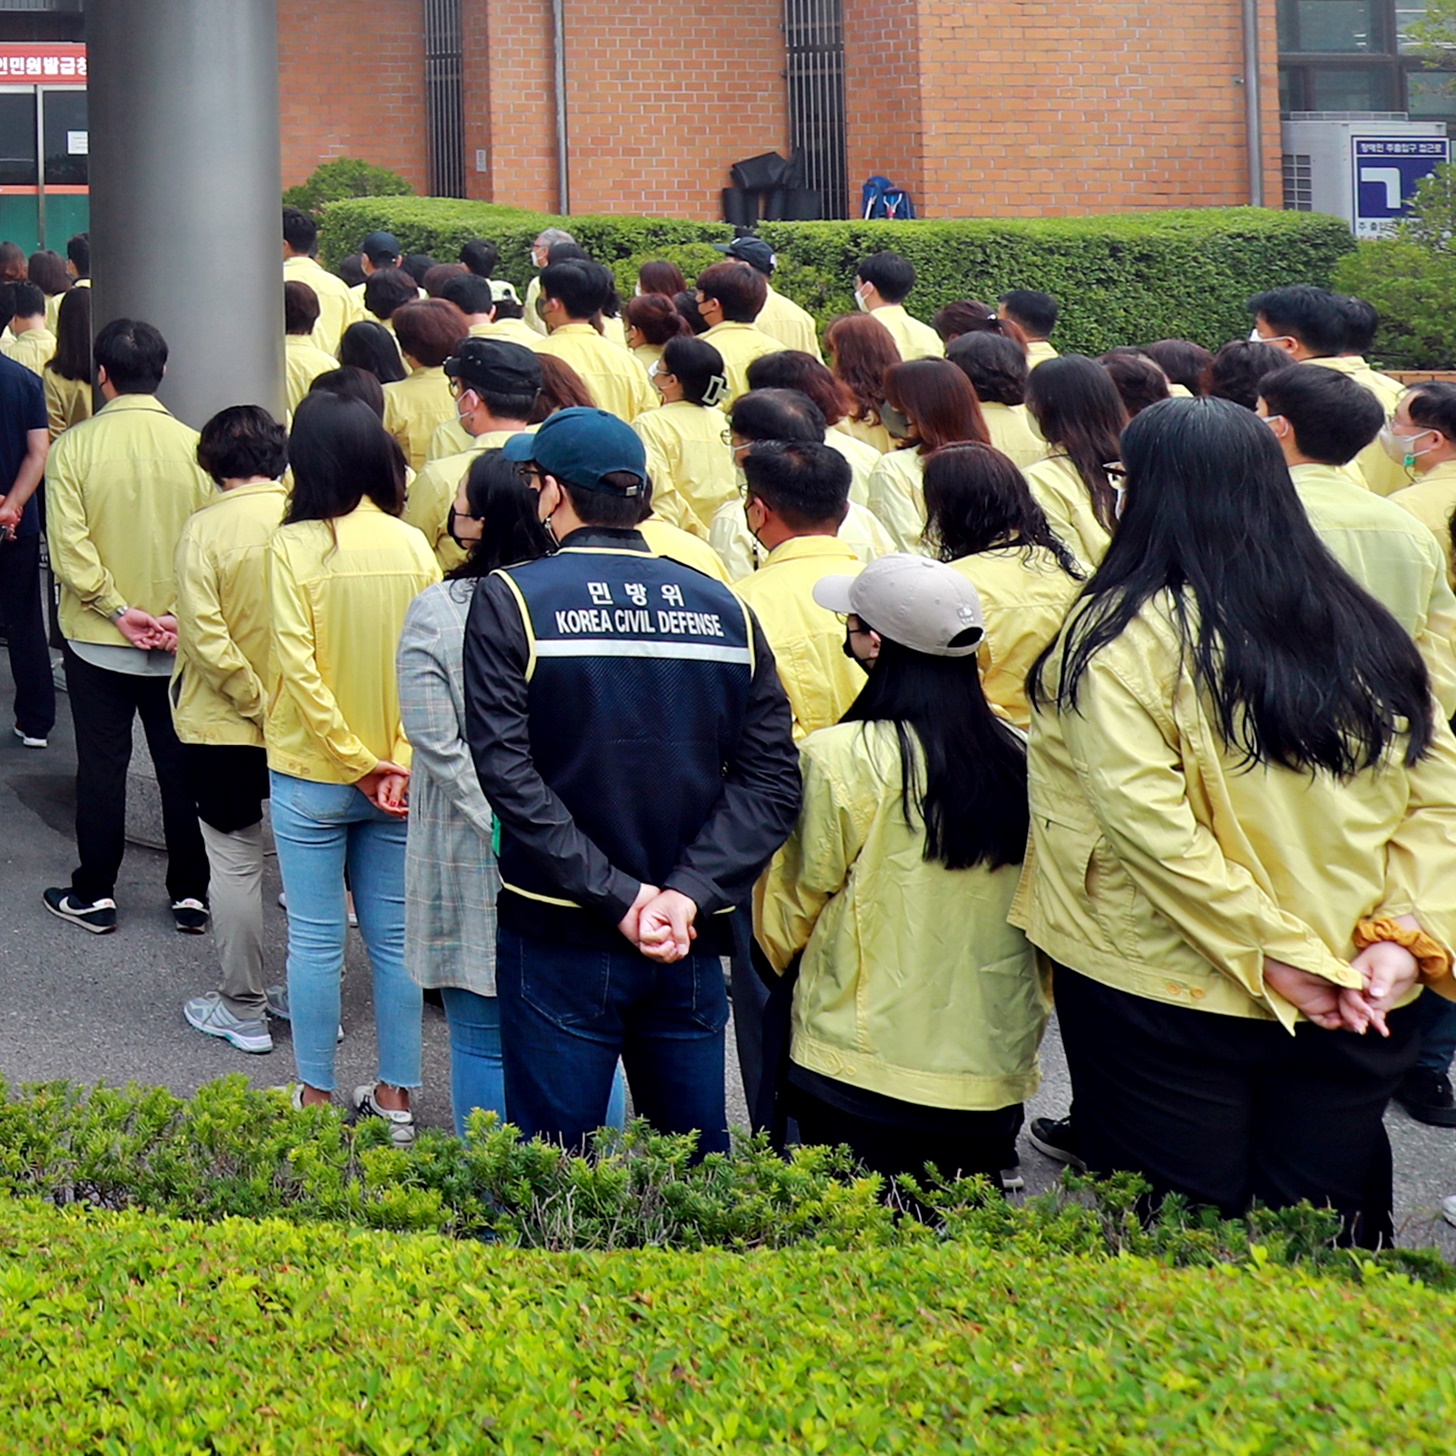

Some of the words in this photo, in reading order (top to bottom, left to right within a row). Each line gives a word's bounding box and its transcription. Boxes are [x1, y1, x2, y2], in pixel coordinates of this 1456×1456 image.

[555, 609, 614, 634] KOREA
[614, 611, 656, 633] CIVIL
[658, 611, 725, 637] DEFENSE
